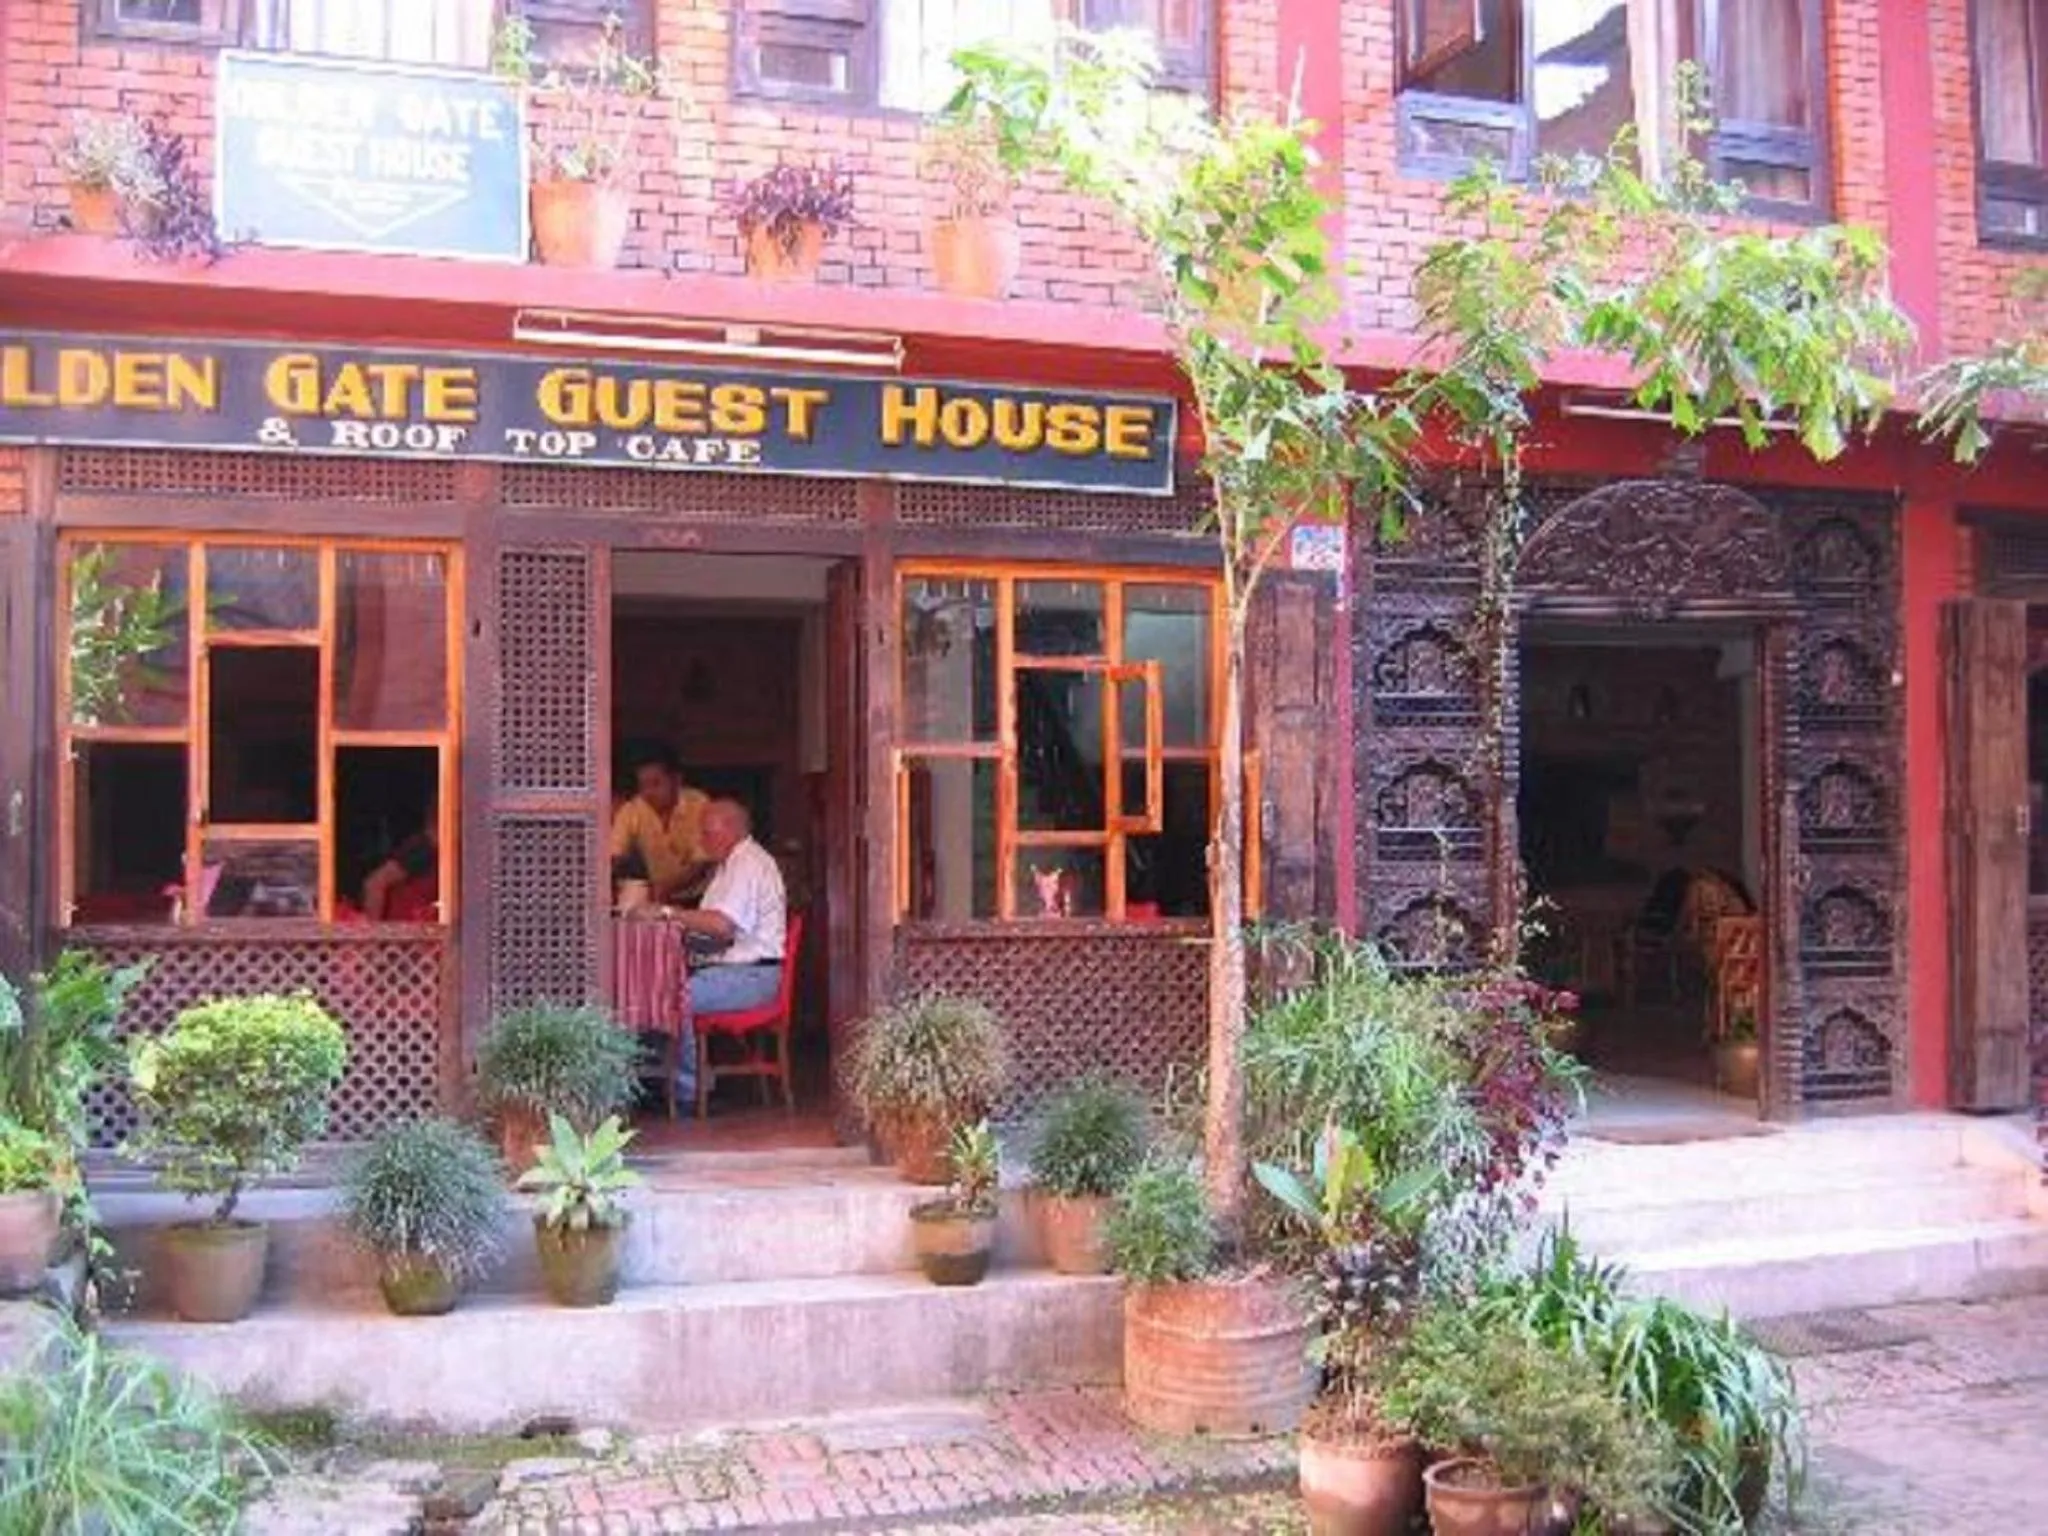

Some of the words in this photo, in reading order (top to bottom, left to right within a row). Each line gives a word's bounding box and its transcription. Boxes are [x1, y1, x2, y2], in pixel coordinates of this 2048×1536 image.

[257, 416, 298, 447] &
[331, 419, 469, 453] ROOF
[505, 429, 597, 456] TOP
[264, 353, 478, 422] GATE
[537, 367, 829, 439] GUEST
[881, 384, 1154, 458] HOUSE
